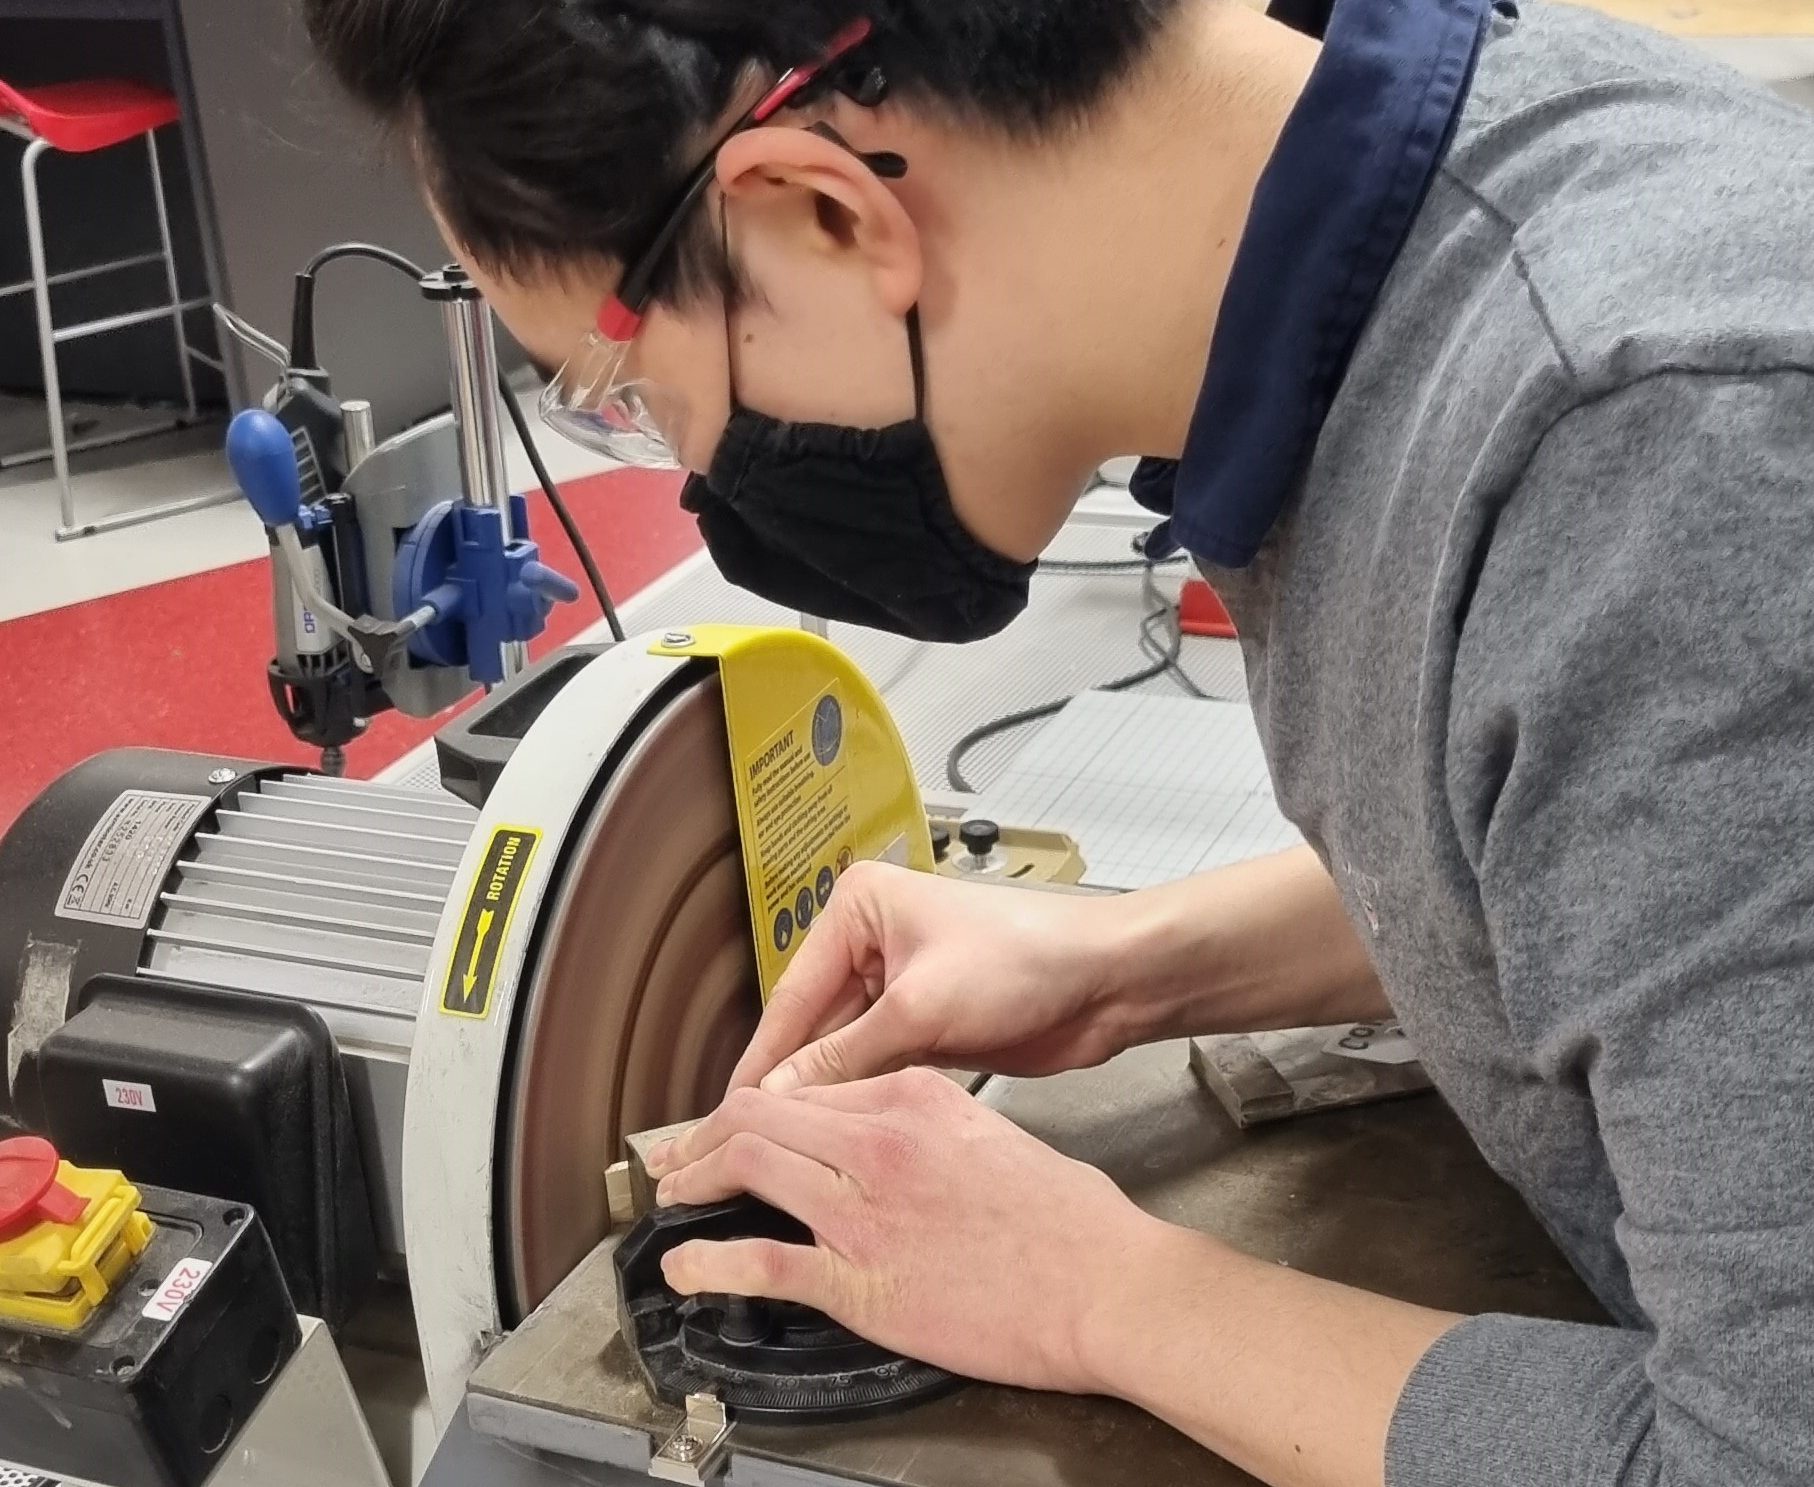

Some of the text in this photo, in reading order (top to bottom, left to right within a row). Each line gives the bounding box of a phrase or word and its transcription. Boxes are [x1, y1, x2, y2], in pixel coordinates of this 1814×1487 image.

[750, 730, 794, 780] IMPORTANT
[486, 836, 521, 901] ROTATION
[115, 1087, 143, 1106] 230V
[156, 1267, 200, 1313] 230V
[831, 1375, 851, 1386] 75
[875, 1364, 899, 1377] 90
